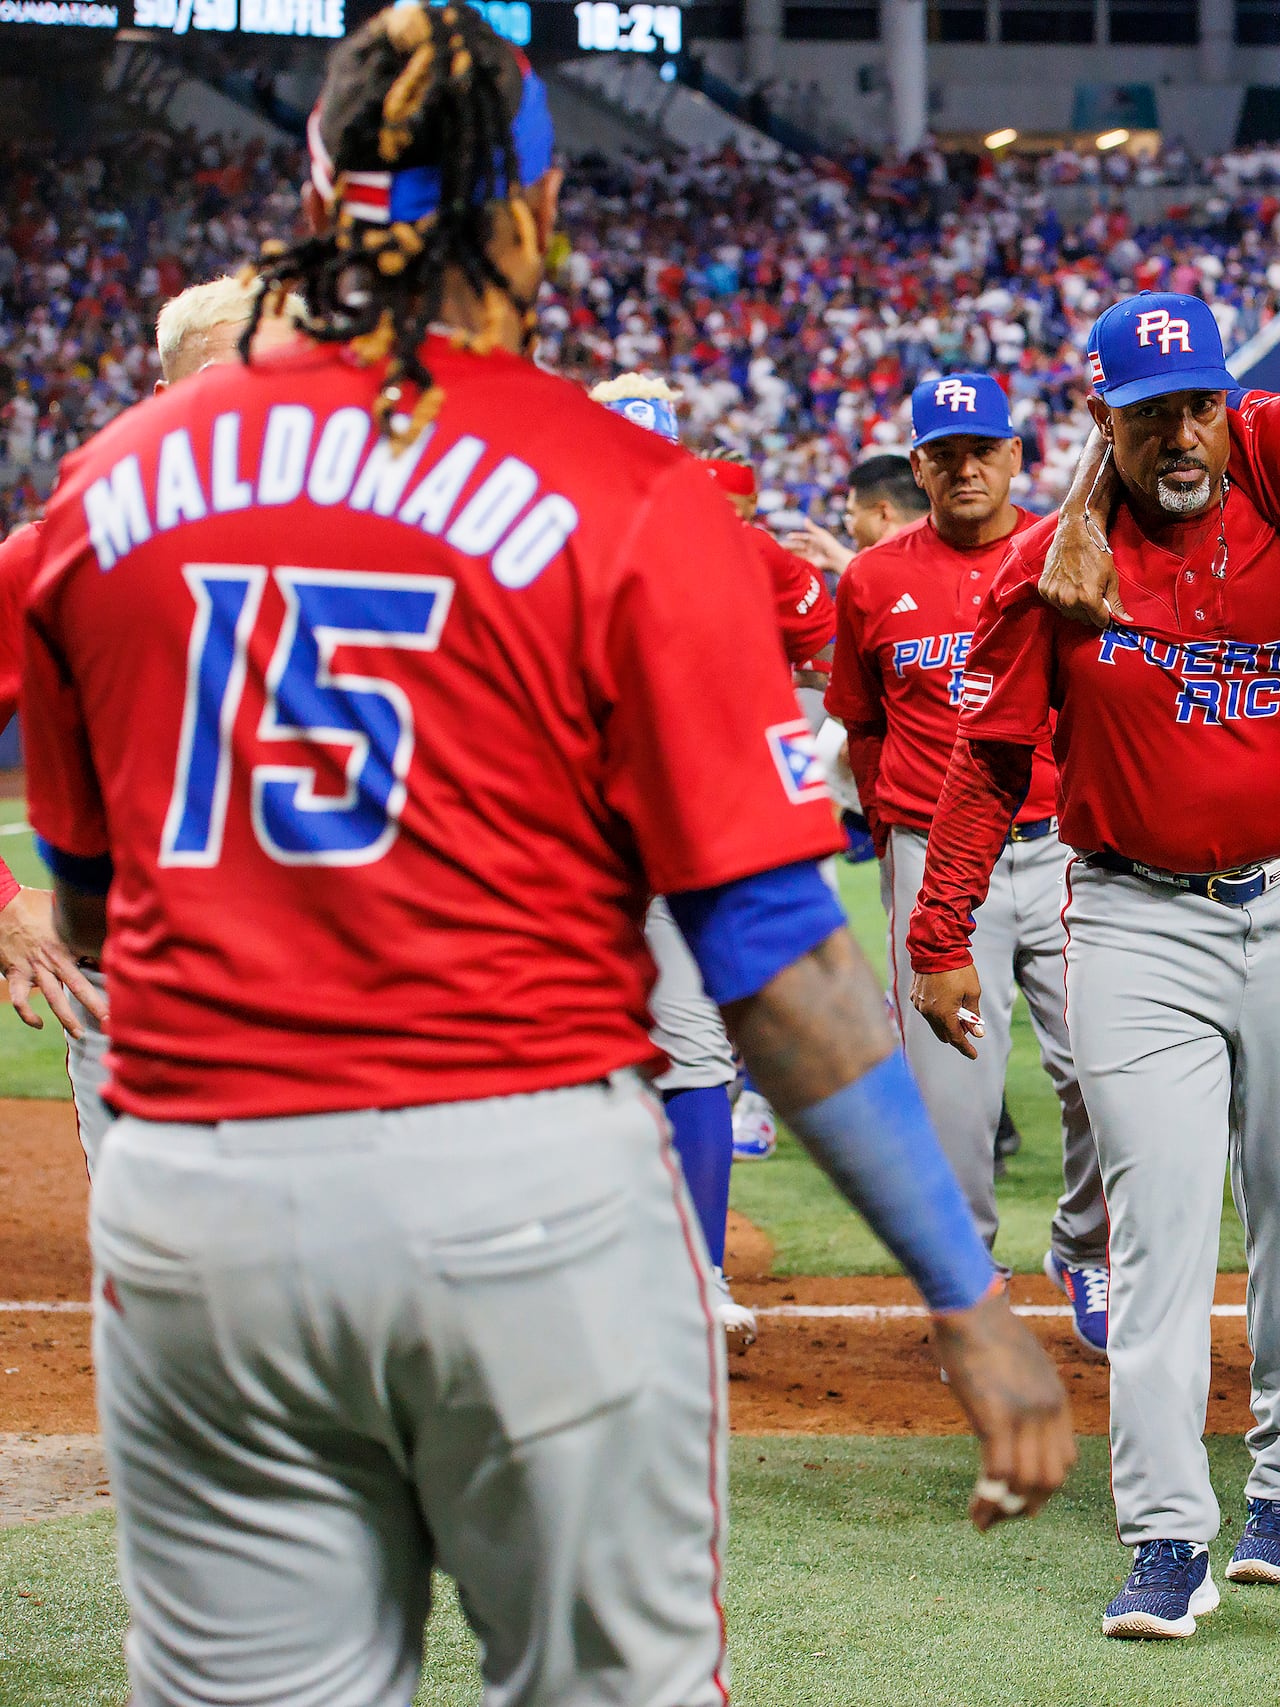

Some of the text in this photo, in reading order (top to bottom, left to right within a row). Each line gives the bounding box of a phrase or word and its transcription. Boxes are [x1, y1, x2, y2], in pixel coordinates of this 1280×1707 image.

[1135, 308, 1194, 354] PR
[934, 379, 977, 412] PR
[83, 403, 579, 591] MALDONADO
[892, 631, 976, 679] PUE
[157, 564, 455, 867] 15
